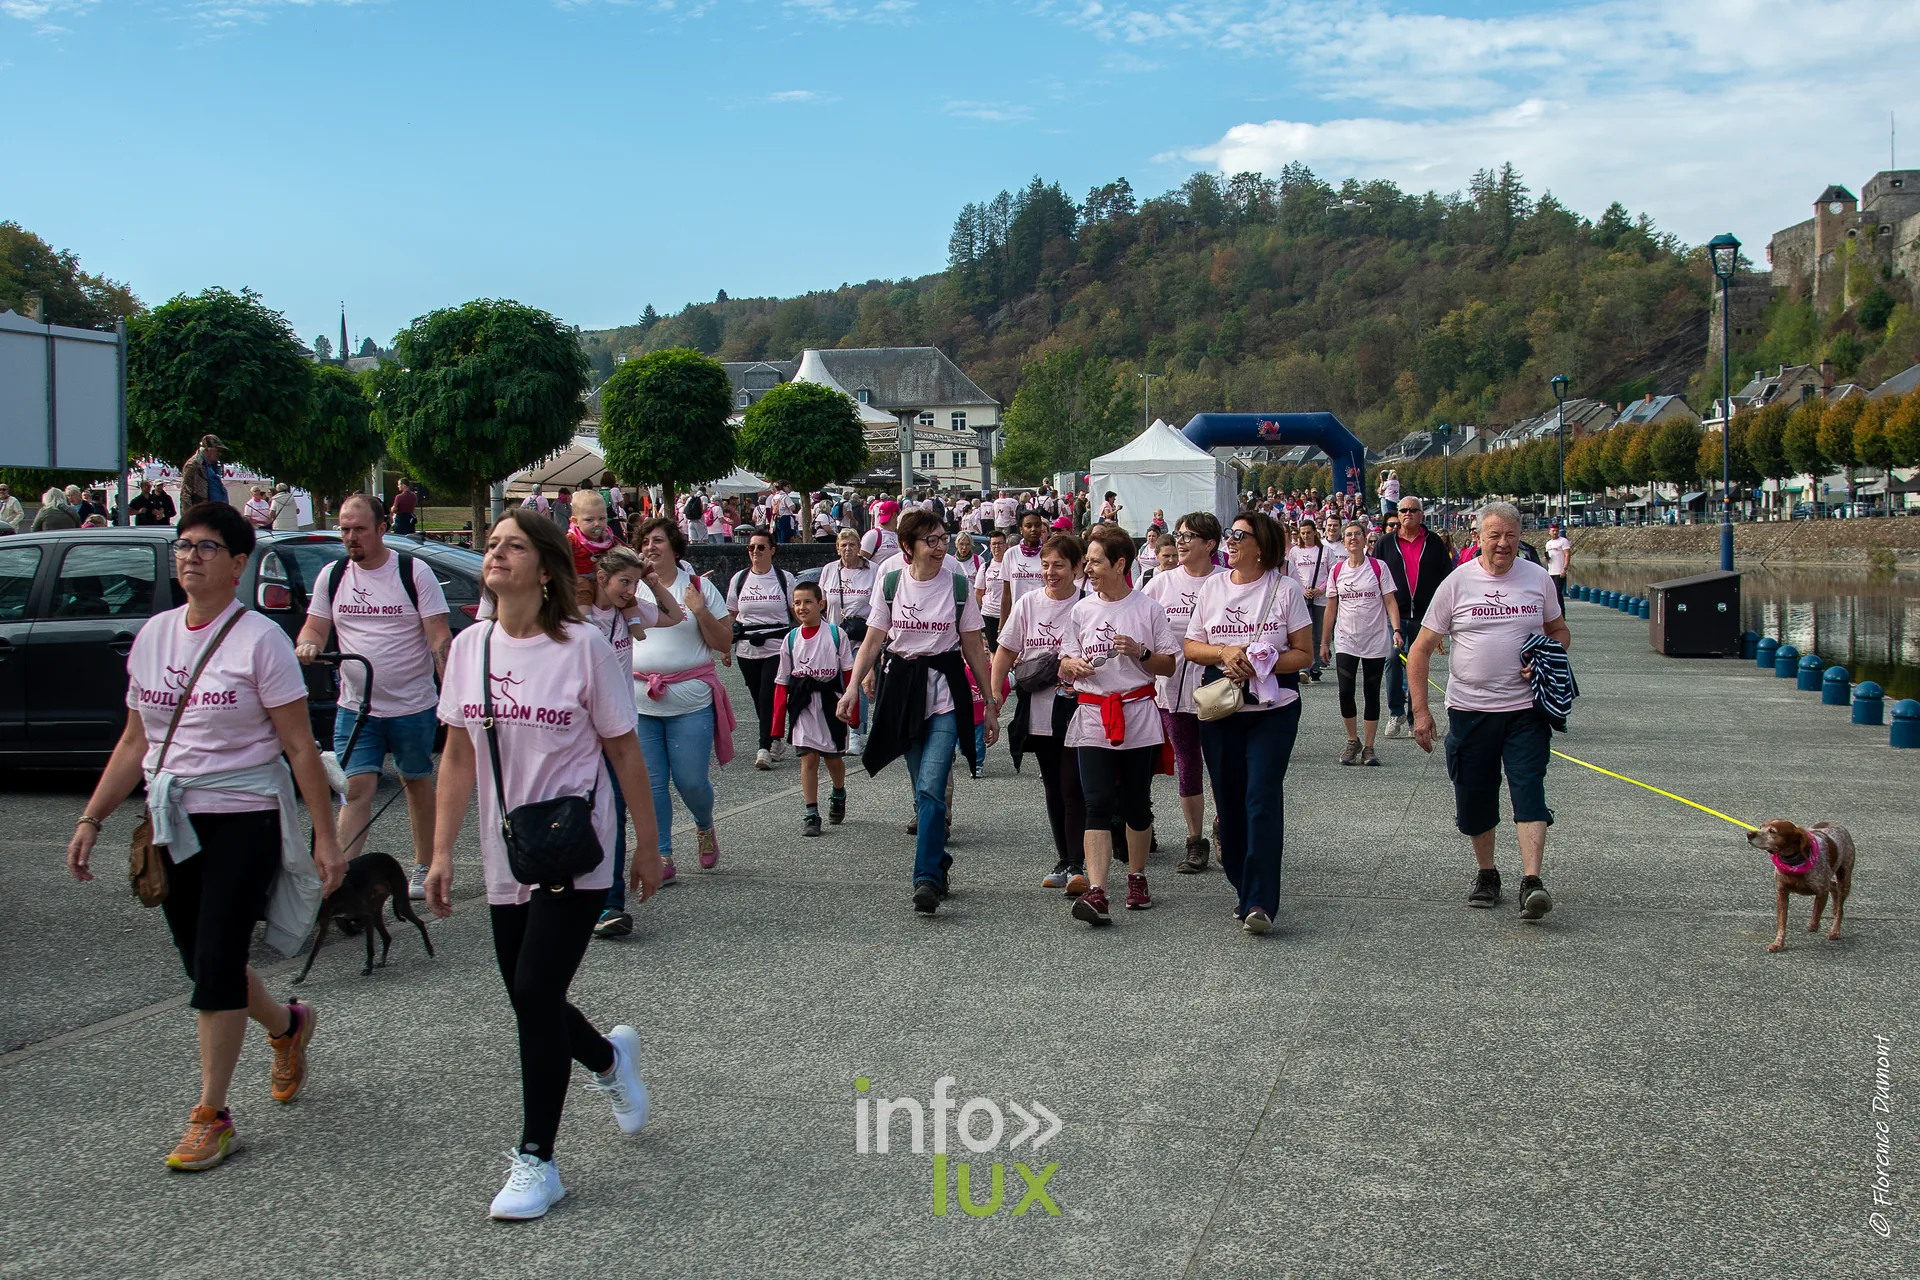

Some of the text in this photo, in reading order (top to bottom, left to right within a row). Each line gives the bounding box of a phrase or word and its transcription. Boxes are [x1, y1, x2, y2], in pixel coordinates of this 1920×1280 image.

[338, 604, 404, 615] BOUILLON ROSE
[1471, 605, 1538, 617] BOUILLON ROSE
[1211, 623, 1255, 635] BOUILLON
[820, 668, 836, 676] ROSE
[202, 690, 238, 705] ROSE
[536, 707, 573, 726] ROSE
